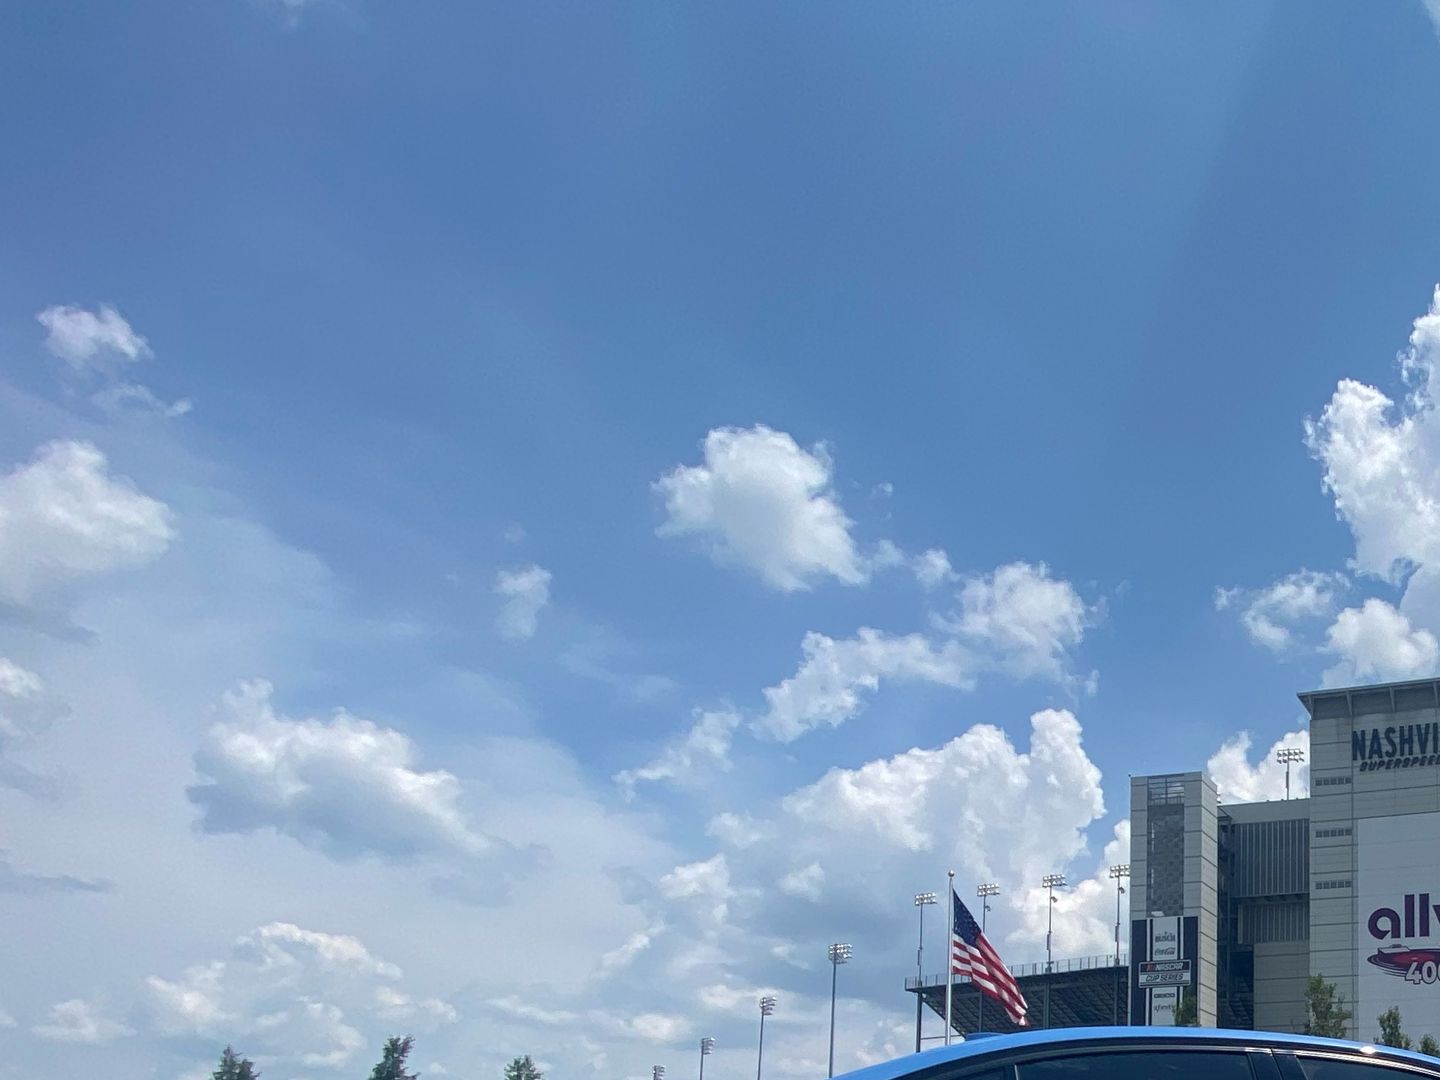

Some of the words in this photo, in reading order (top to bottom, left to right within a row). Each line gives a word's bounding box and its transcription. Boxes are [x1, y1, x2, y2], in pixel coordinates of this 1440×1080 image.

[1155, 962, 1184, 971] NASCAR
[1145, 973, 1160, 982] CUP
[1160, 973, 1184, 982] SERIES
